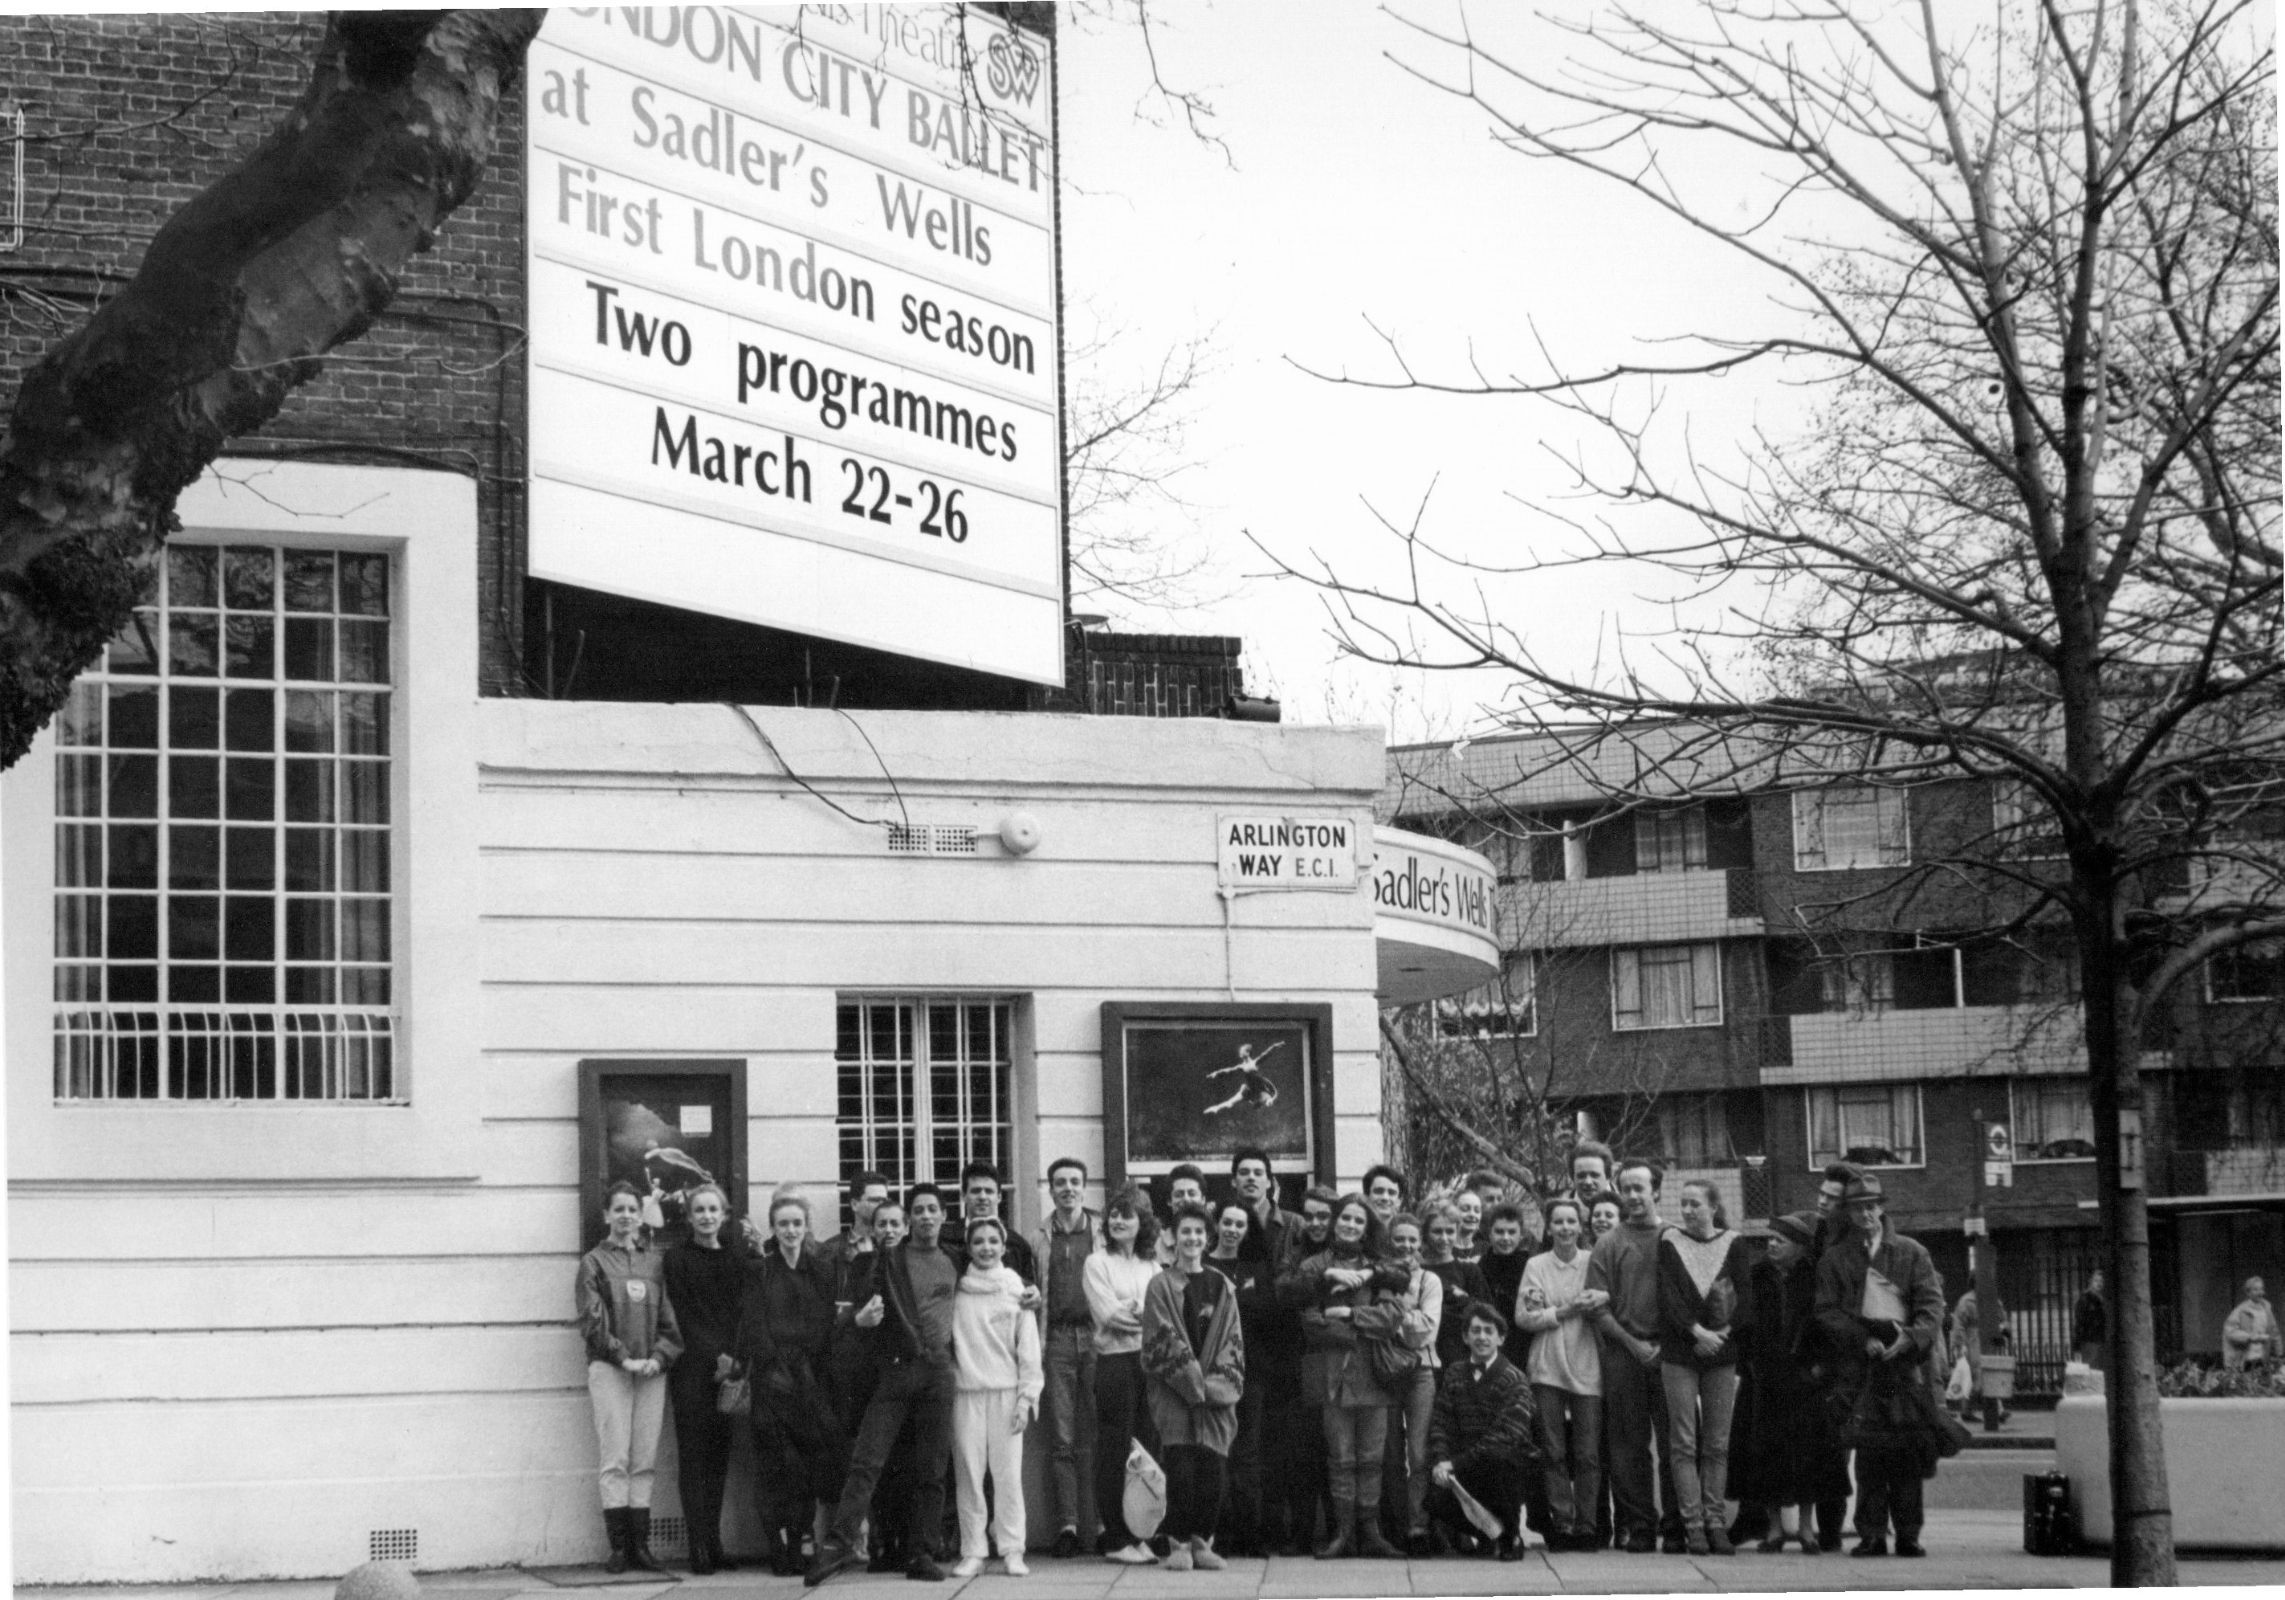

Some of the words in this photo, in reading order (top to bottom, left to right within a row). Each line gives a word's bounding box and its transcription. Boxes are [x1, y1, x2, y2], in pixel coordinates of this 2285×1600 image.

[542, 67, 590, 126] at
[631, 85, 829, 208] Sadler's
[876, 172, 993, 266] Wells
[782, 41, 888, 130] CITY
[908, 89, 1045, 193] BALLET
[557, 162, 663, 255] First
[694, 207, 876, 322] London
[901, 292, 1036, 375] season
[585, 279, 693, 367] Two
[738, 341, 1018, 462] programmes
[651, 405, 812, 504] March
[841, 458, 969, 544] 22-26
[1229, 823, 1346, 848] ARLINGTON
[1238, 855, 1282, 877] WAY
